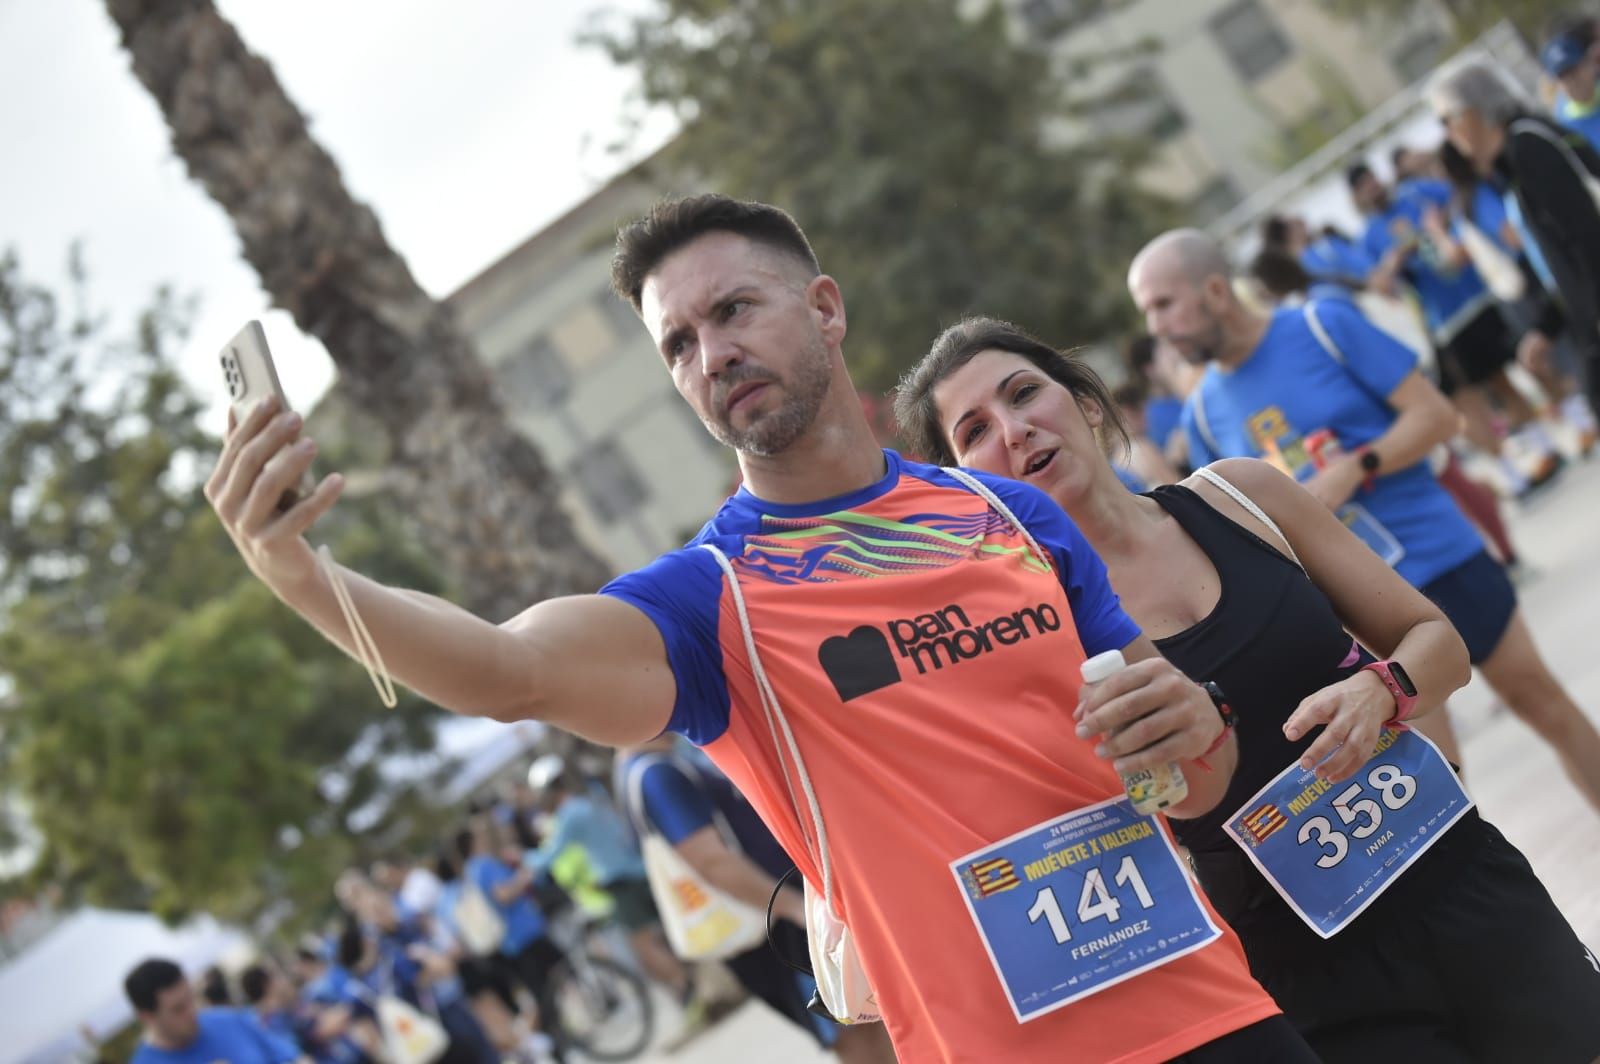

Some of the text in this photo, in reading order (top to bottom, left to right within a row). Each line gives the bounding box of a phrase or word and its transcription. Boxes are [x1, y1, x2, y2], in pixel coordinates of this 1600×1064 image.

[887, 604, 971, 657] pan
[907, 603, 1061, 674] moreno
[1287, 776, 1333, 816] MUÉVE
[1297, 763, 1417, 869] 358
[1024, 821, 1154, 881] MUÉVETE X VALENCIA
[1049, 825, 1061, 837] 24
[1366, 830, 1394, 857] INMA
[1026, 855, 1155, 945] 141
